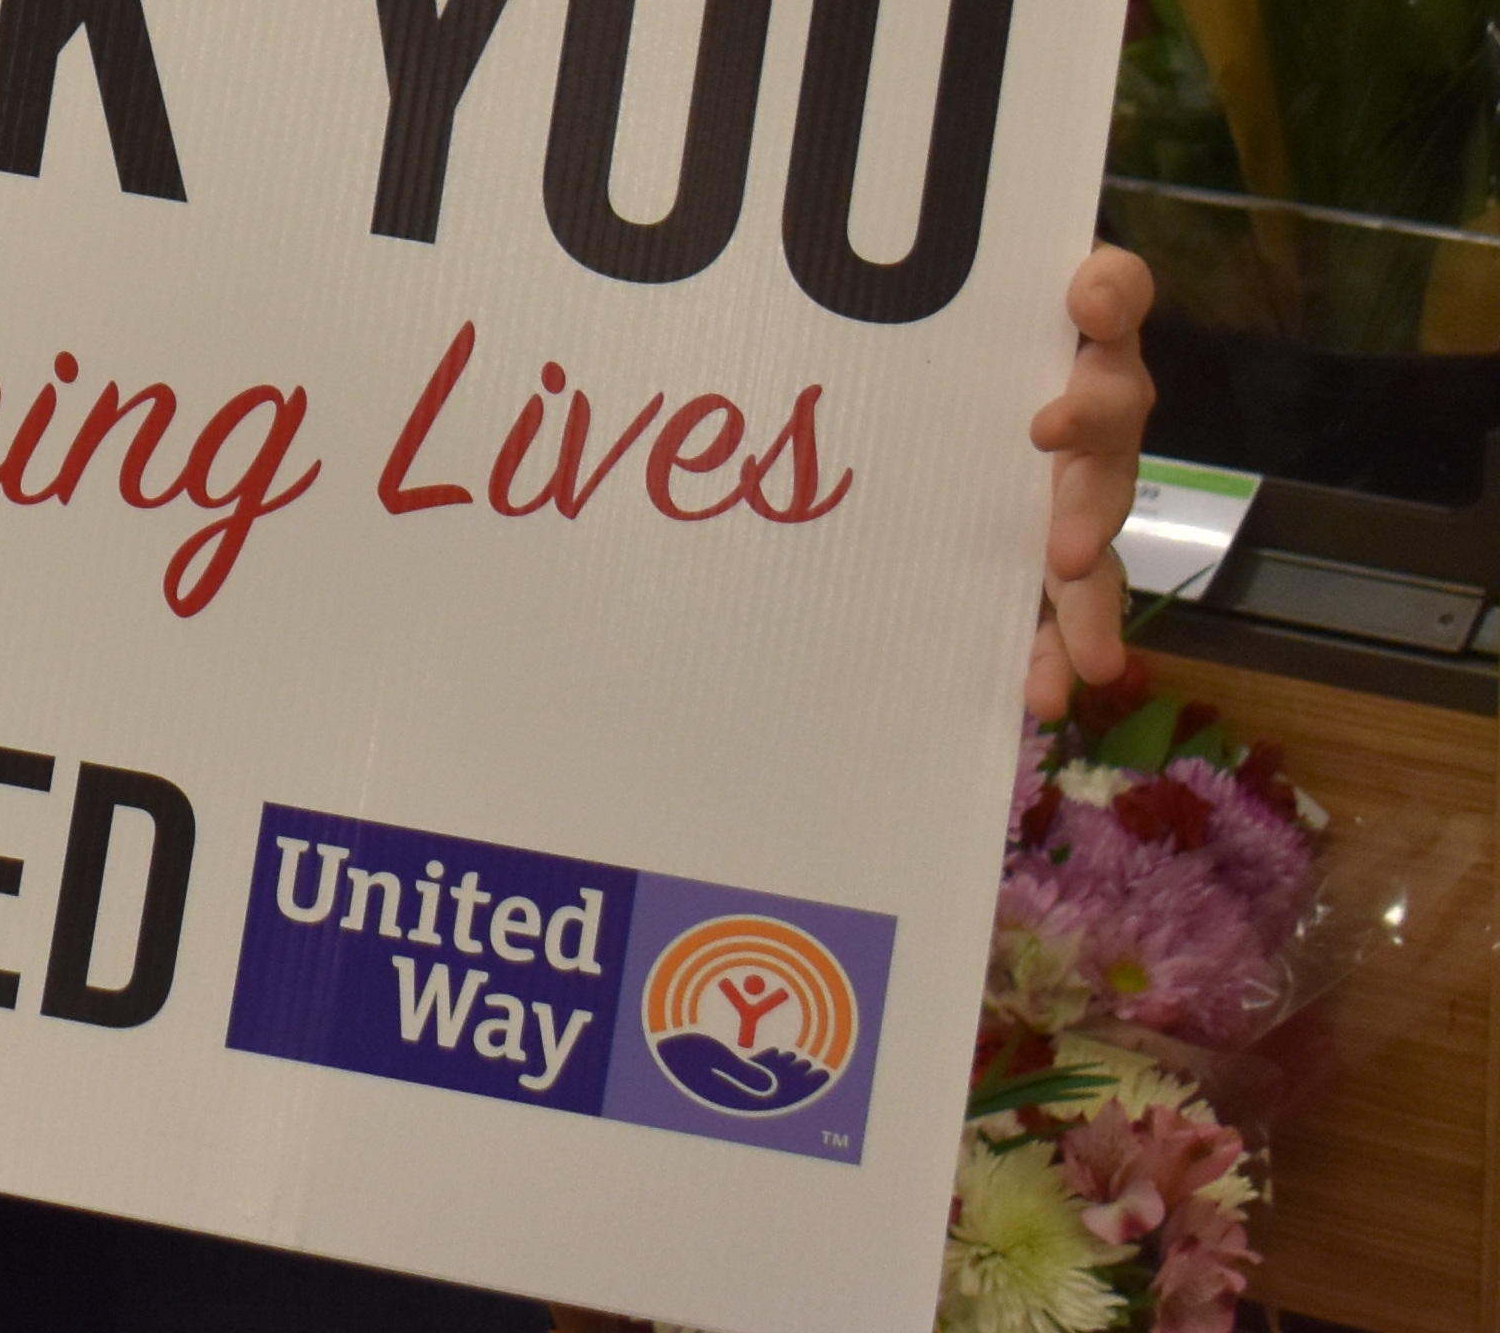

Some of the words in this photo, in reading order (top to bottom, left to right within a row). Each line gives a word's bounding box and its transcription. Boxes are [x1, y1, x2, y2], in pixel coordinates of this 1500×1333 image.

[378, 321, 854, 523] Lives
[276, 835, 603, 975] United
[392, 955, 592, 1092] Way
